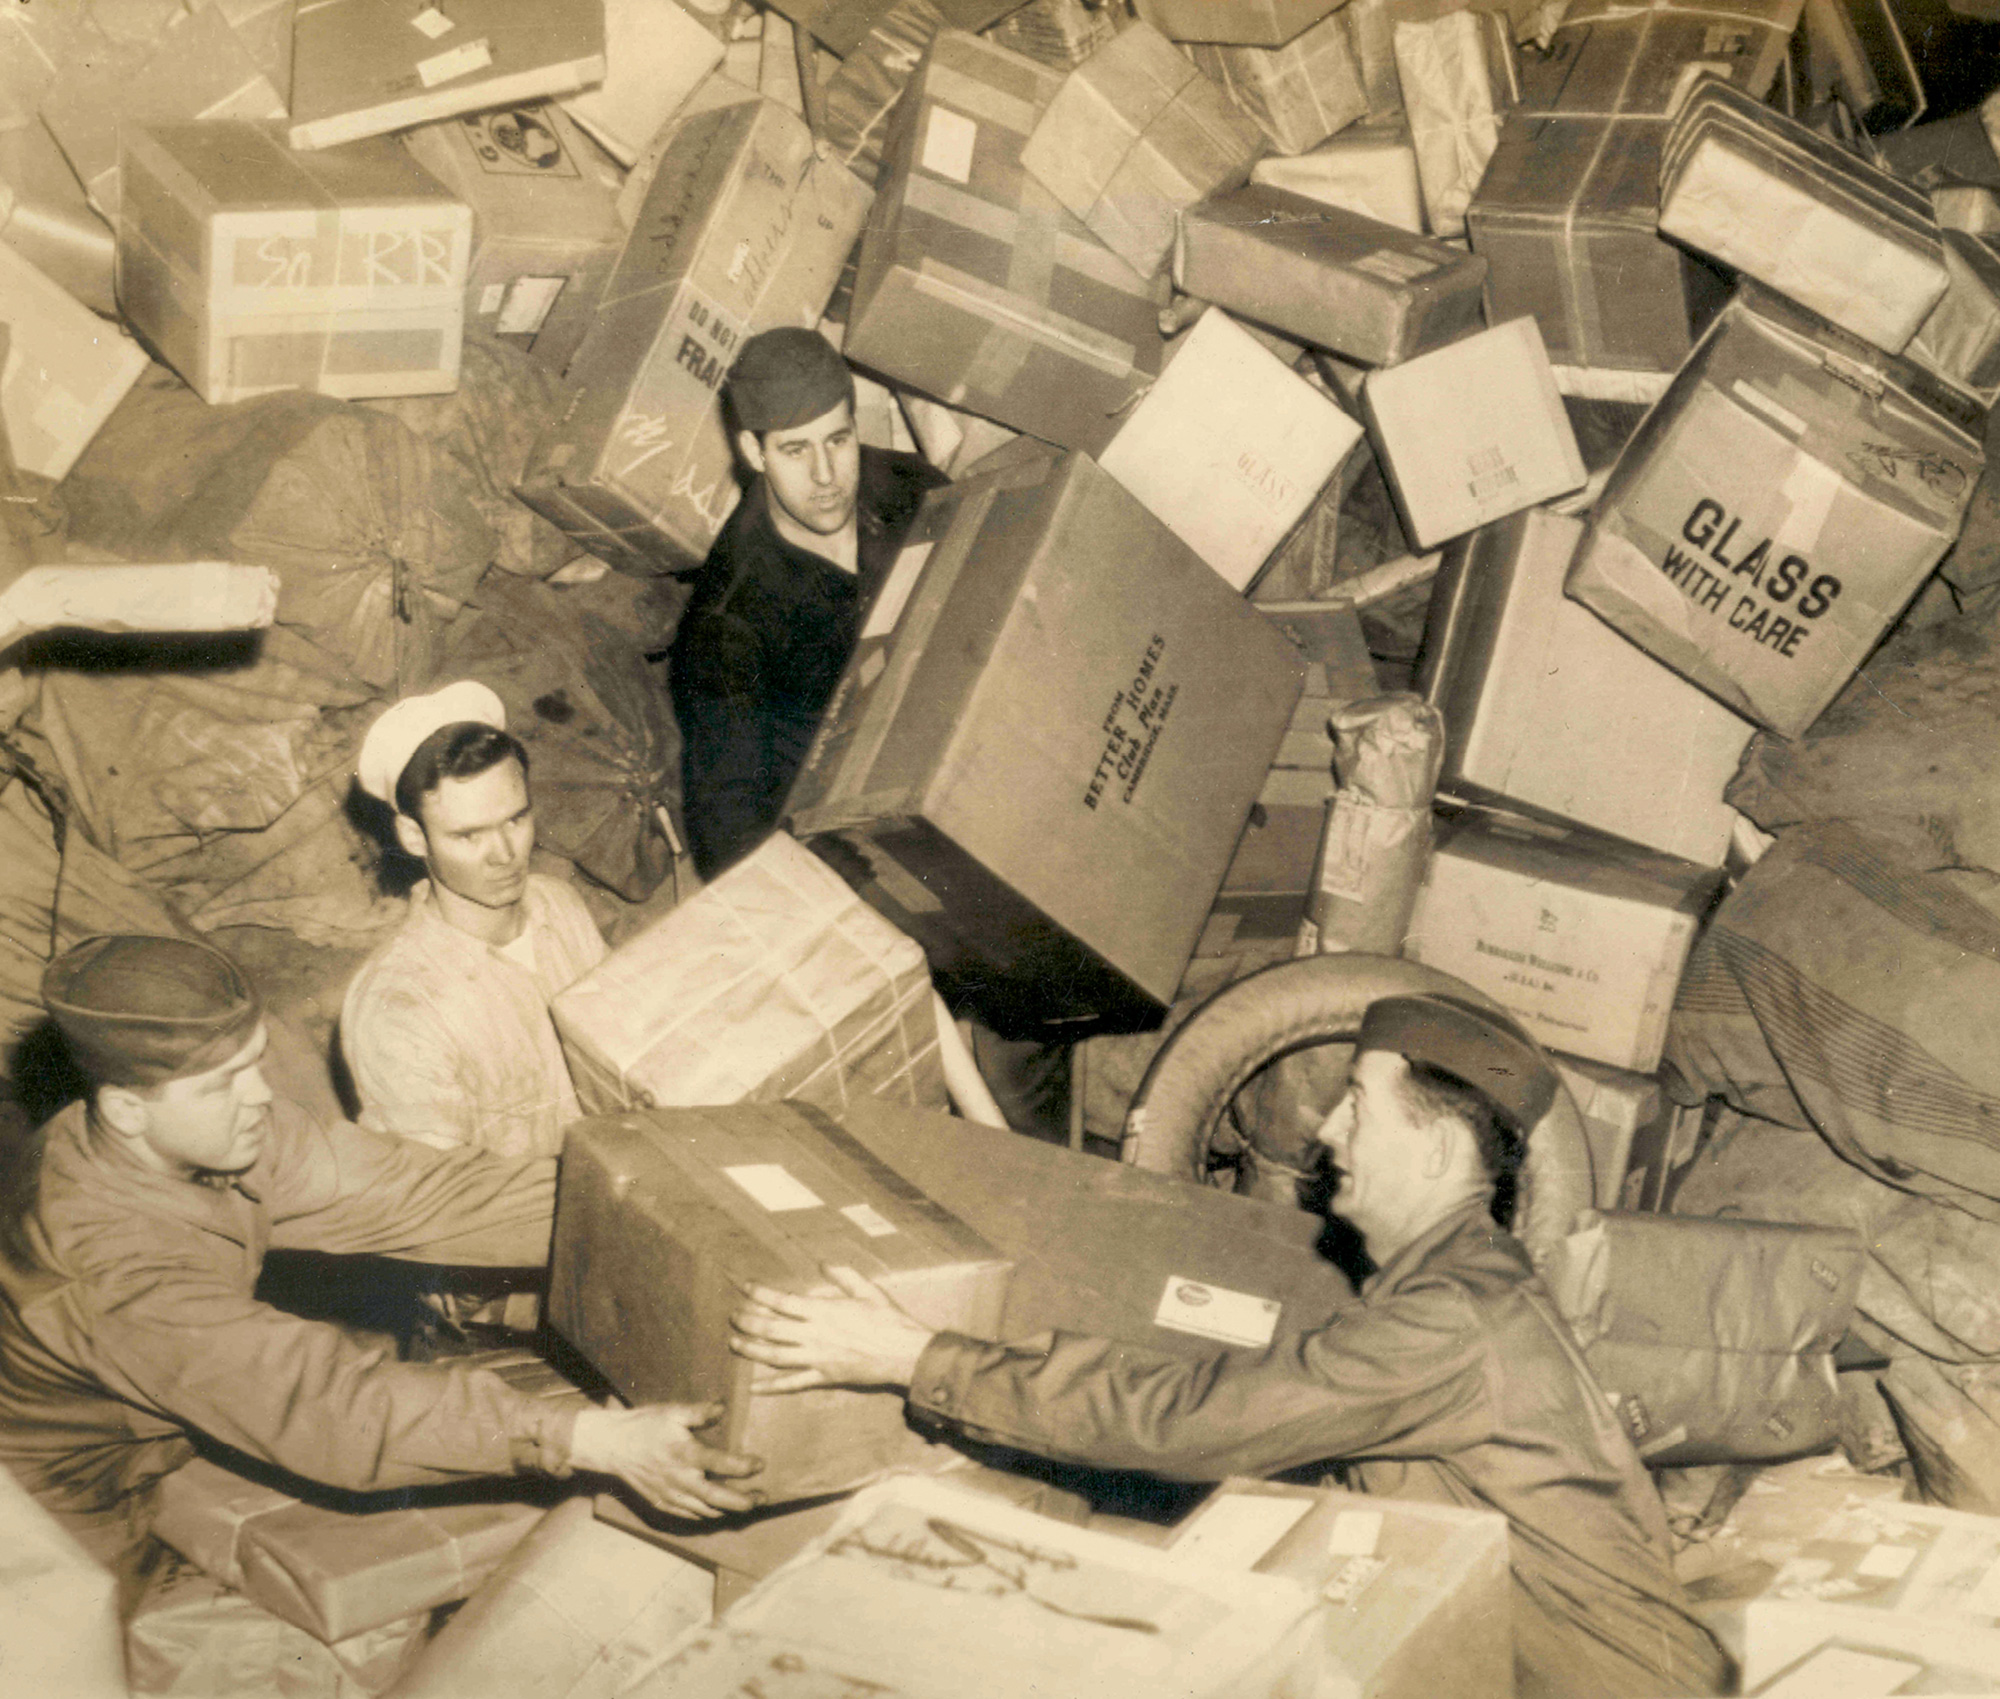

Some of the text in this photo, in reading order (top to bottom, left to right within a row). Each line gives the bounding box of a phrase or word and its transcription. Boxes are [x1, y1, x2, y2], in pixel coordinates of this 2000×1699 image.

[1661, 543, 1810, 659] WITH CARE
[1681, 497, 1842, 620] GLASS
[1083, 633, 1166, 812] BETTER HOMES
[1102, 690, 1125, 734] FROM
[1116, 686, 1164, 781] Club Plan
